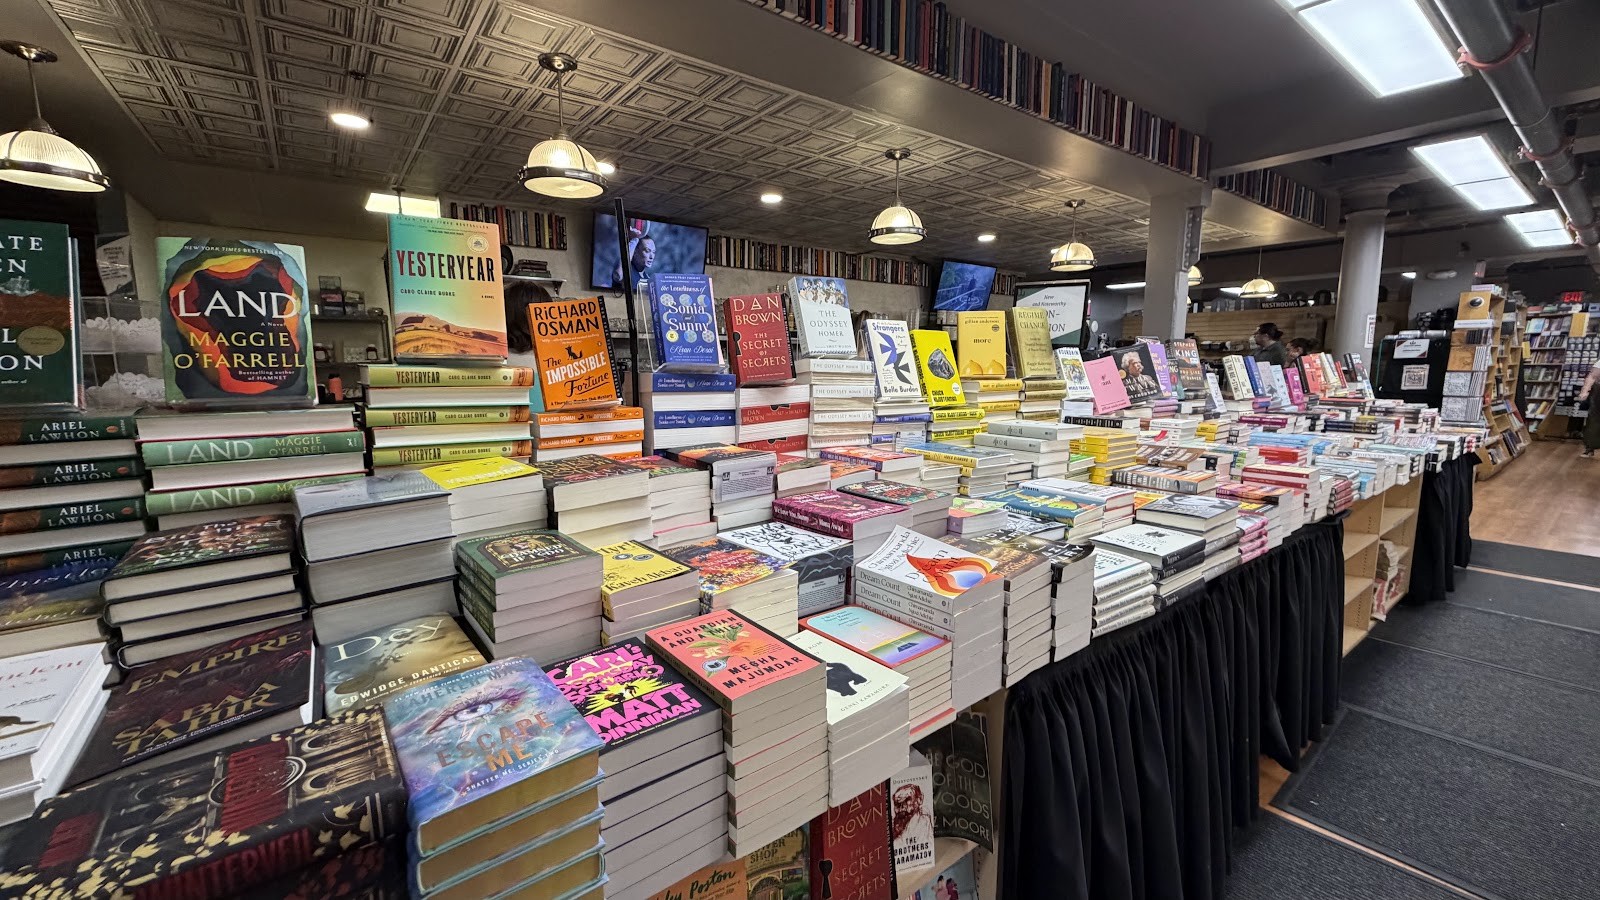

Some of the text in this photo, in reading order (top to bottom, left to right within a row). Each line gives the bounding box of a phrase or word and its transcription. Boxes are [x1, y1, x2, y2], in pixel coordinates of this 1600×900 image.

[396, 250, 496, 282] YESTERYEAR
[177, 289, 299, 320] LAND
[668, 301, 706, 315] Sonia
[733, 296, 780, 312] DAN
[1261, 301, 1299, 309] RESTROOMS
[735, 312, 781, 326] BROWN
[819, 310, 837, 318] THE
[1018, 311, 1045, 319] REGIME
[537, 316, 600, 337] OSMAN
[668, 317, 709, 334] Sunny
[810, 320, 848, 328] ODYSSEY
[872, 322, 905, 334] Strangers
[189, 331, 291, 347] MAGGIE
[742, 338, 783, 351] SECRET
[174, 352, 306, 369] O'FARRELL
[1175, 349, 1198, 357] KING
[543, 357, 562, 369] The
[396, 371, 440, 384] YESTERYEAR
[563, 372, 610, 398] Fortune
[883, 385, 919, 394] Belle Burden
[41, 420, 87, 432] ARIEL
[393, 411, 437, 425] YESTERYEAR
[29, 430, 100, 441] LAWHON
[166, 436, 321, 464] LAND MAGGIE
[269, 444, 328, 456] O'FARRELL
[398, 448, 442, 463] YESTERYEAR
[42, 471, 112, 483] LAWHON
[54, 463, 99, 475] ARIEL
[169, 487, 256, 513] LAND
[60, 504, 103, 516] ARIEL
[1004, 505, 1032, 516] Changed
[48, 512, 116, 527] LAWHON
[63, 547, 106, 561] ARIEL
[604, 565, 684, 592] Kaveh Akbar
[860, 571, 901, 592] Dream Count
[860, 586, 902, 607] Dream Count
[861, 601, 882, 615] Dream
[881, 609, 902, 622] Count
[669, 621, 745, 649] AND THIEF
[673, 616, 737, 638] GUARDIAN
[806, 640, 823, 651] ROM
[125, 631, 301, 696] EMPIRE
[727, 655, 778, 676] MEGHA
[340, 655, 477, 707] EDWIDGE DANTICAT
[722, 656, 803, 690] MAJUMDAR
[407, 690, 420, 699] NEW
[421, 685, 438, 693] YORK
[440, 679, 461, 688] TIMES
[840, 683, 890, 712] GENKI KAWAMURA
[112, 682, 282, 746] SABAA
[584, 682, 691, 734] MATT
[123, 694, 281, 757] TAHIR
[597, 698, 702, 745] DINNIMAN
[435, 711, 554, 768] ESCAPE
[484, 742, 533, 772] ME
[925, 749, 943, 767] HE
[465, 774, 500, 793] SHATTER
[543, 748, 560, 759] TWO
[946, 754, 986, 779] GOD
[827, 785, 882, 826] DAN
[827, 802, 883, 848] BROWN
[942, 815, 991, 841] MOORE
[905, 836, 917, 845] THE
[750, 848, 779, 864] SHOP
[894, 842, 929, 857] BROTHERS
[896, 850, 932, 865] ARAMAZOV
[835, 846, 883, 882] SECRET
[690, 869, 737, 899] Poston
